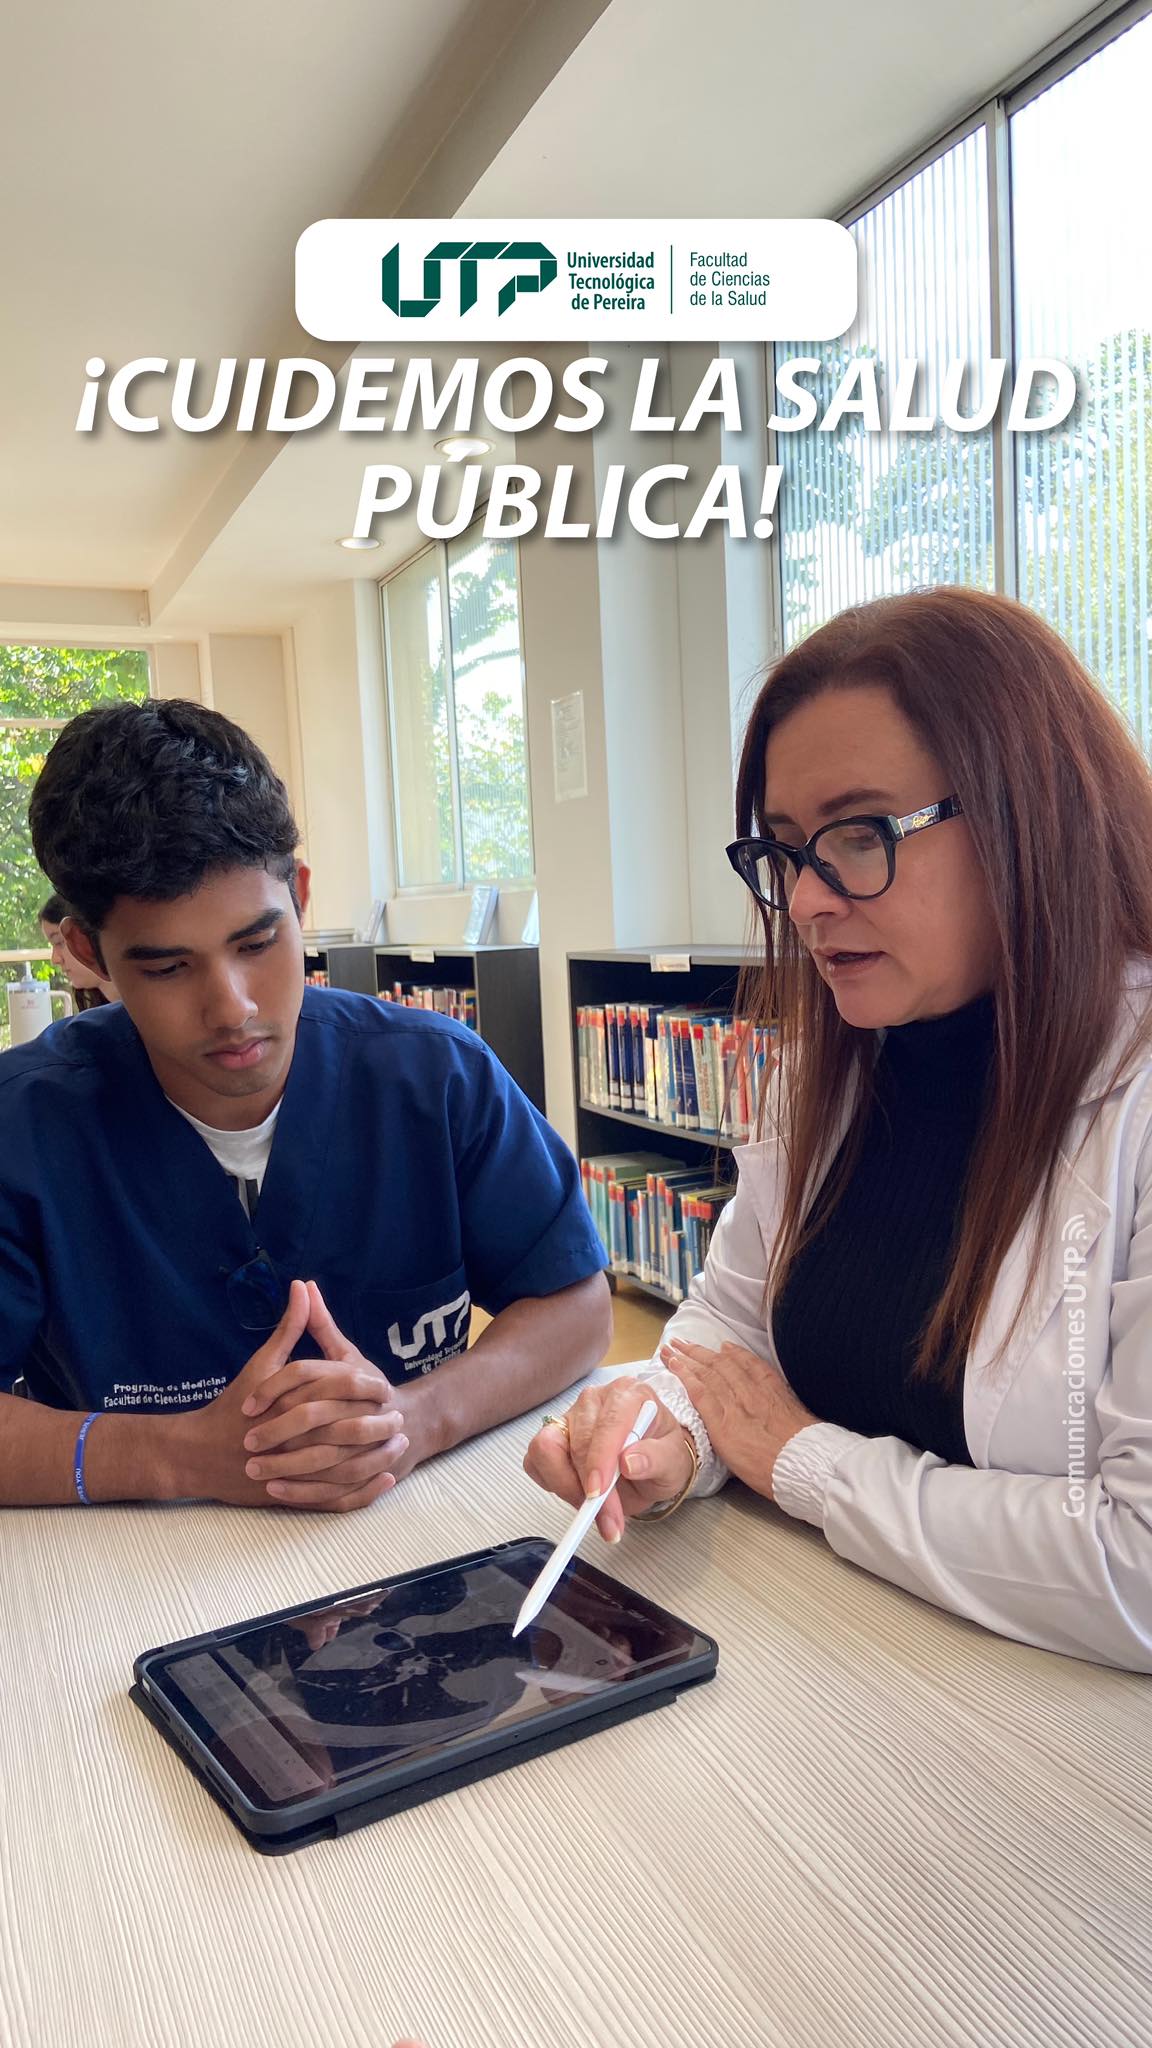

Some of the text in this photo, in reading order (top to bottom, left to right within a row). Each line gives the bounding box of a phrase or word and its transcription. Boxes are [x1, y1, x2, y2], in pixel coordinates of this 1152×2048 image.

[113, 1384, 164, 1394] Programa
[181, 1376, 227, 1391] Medicina
[104, 1394, 141, 1409] Facultad
[142, 1394, 153, 1404] de
[153, 1392, 191, 1405] Ciencias
[192, 1391, 203, 1402] de
[204, 1389, 213, 1400] la
